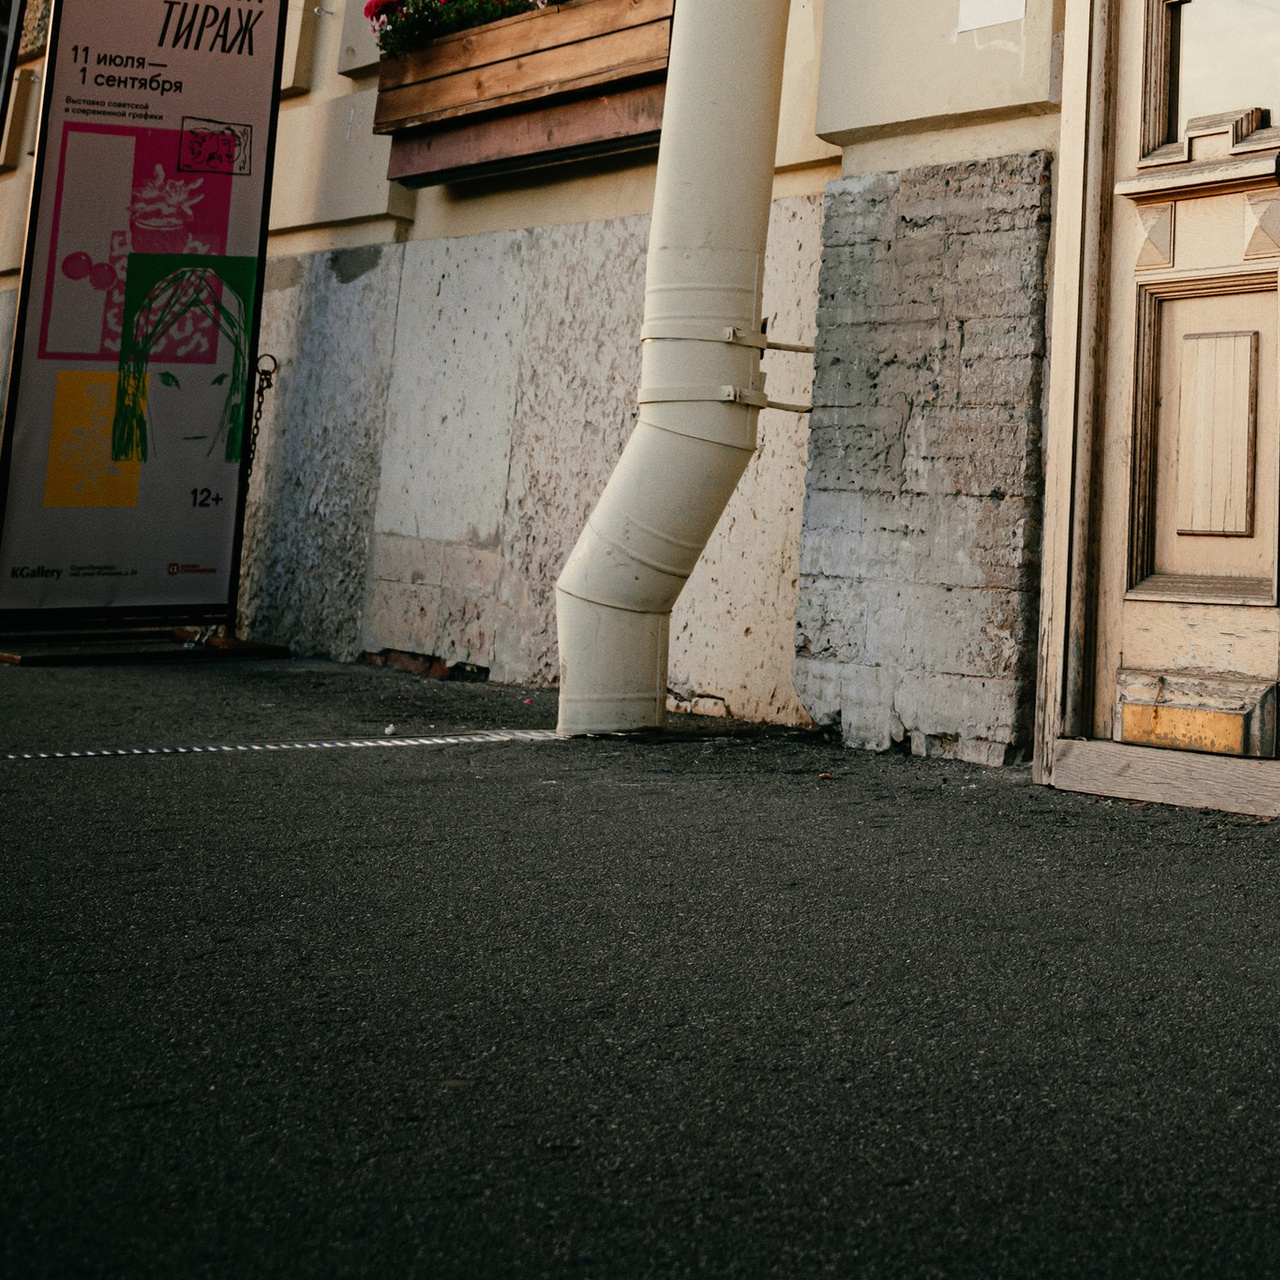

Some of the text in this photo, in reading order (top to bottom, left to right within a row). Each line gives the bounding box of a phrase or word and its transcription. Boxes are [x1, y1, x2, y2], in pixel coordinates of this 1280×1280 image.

[157, 0, 264, 56] ТИРАЖ
[71, 45, 89, 64] 11
[80, 66, 183, 96] 1 сентября
[65, 95, 149, 110] Выставка советской
[71, 107, 126, 117] современной
[128, 111, 163, 120] графики
[190, 487, 223, 507] 12+
[11, 565, 63, 581] KGallery
